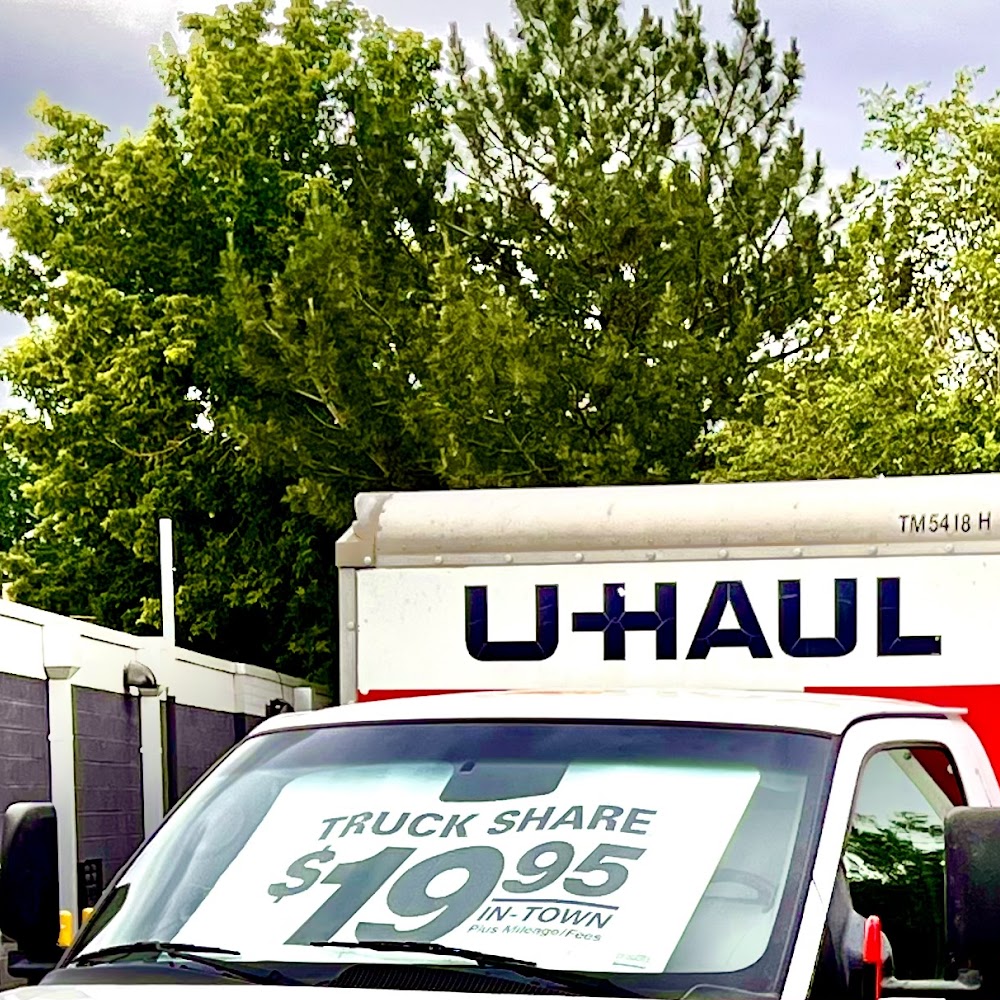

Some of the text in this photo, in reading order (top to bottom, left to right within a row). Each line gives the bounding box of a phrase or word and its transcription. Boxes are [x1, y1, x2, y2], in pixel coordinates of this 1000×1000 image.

[464, 577, 942, 661] U-HAUL
[318, 804, 658, 841] TRUCK SHARE
[477, 906, 615, 930] IN-TOWN
